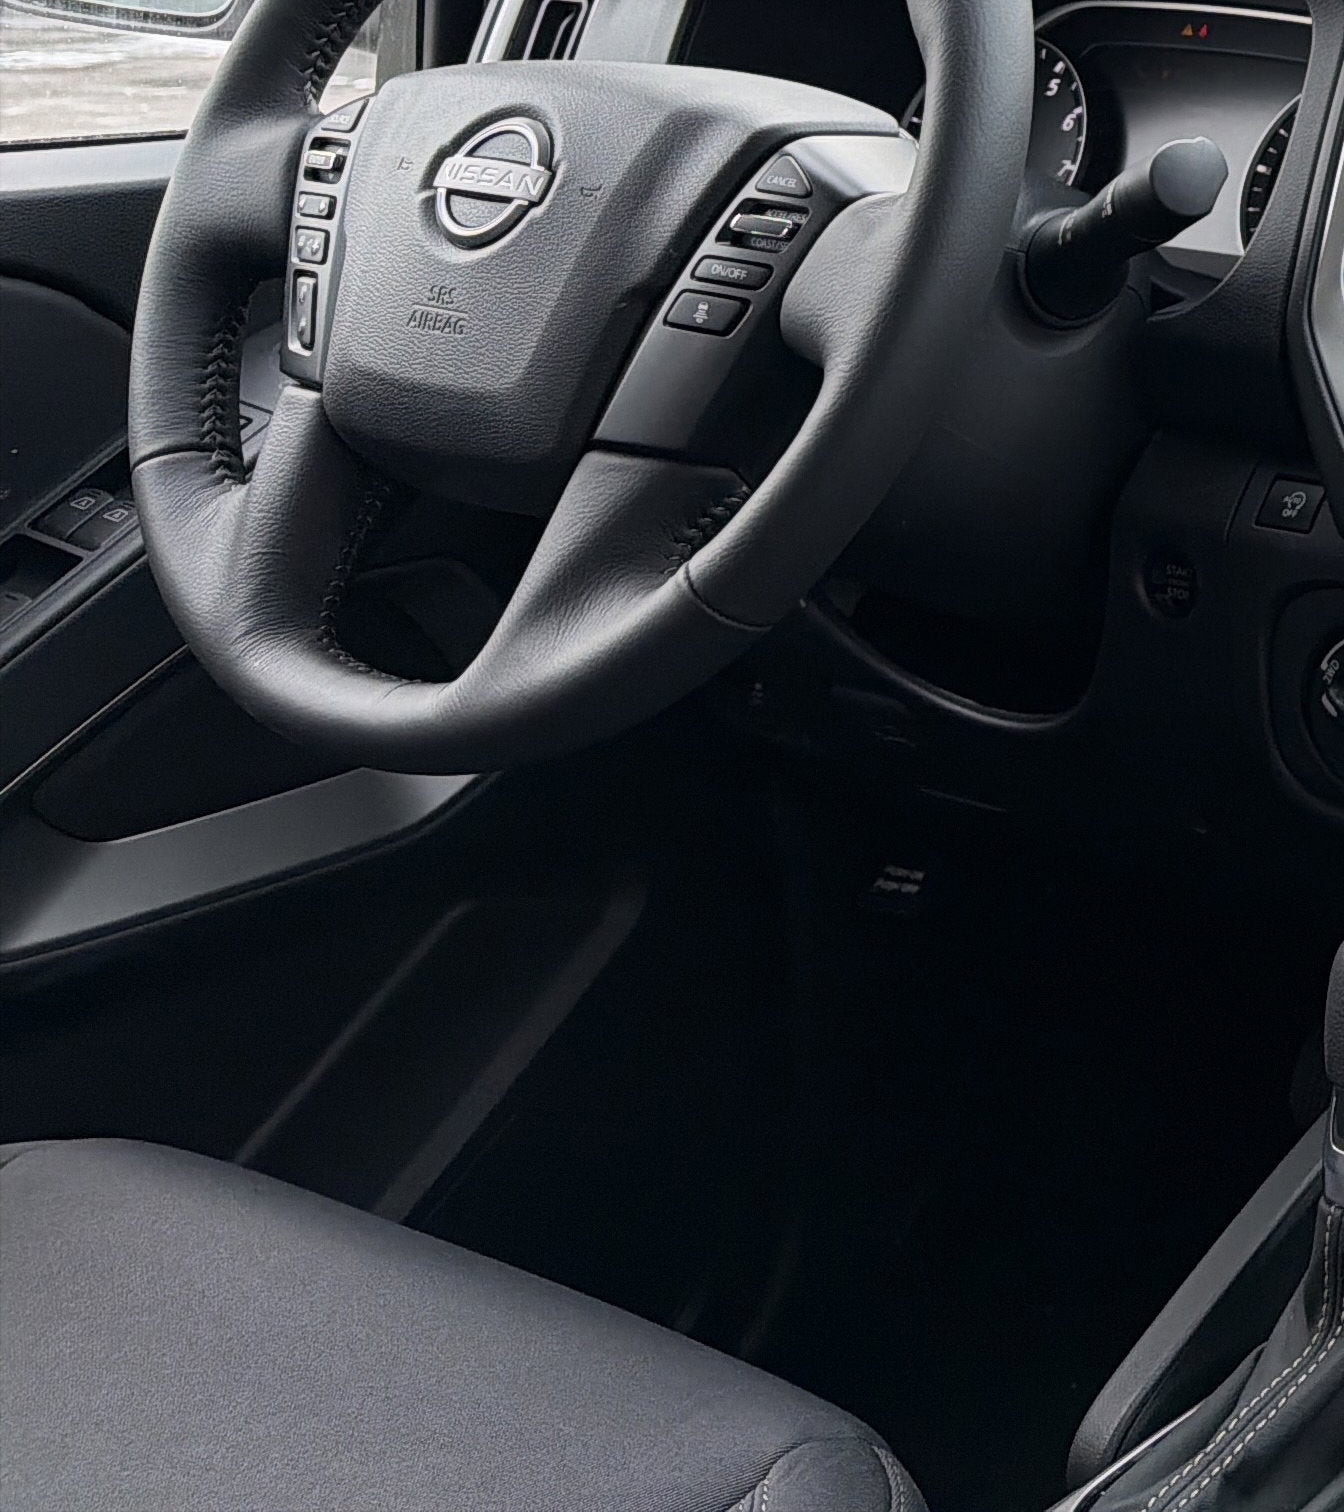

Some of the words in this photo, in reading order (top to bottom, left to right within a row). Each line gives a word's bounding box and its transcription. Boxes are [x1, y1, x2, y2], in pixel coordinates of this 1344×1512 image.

[1043, 78, 1062, 97] 5
[1061, 113, 1078, 132] 6
[443, 162, 546, 196] NISSAN
[766, 175, 798, 189] CANCEL
[711, 263, 748, 280] ON/OFF
[426, 284, 455, 306] SRS
[406, 309, 466, 336] AIRBAG
[1322, 659, 1340, 685] 2WD
